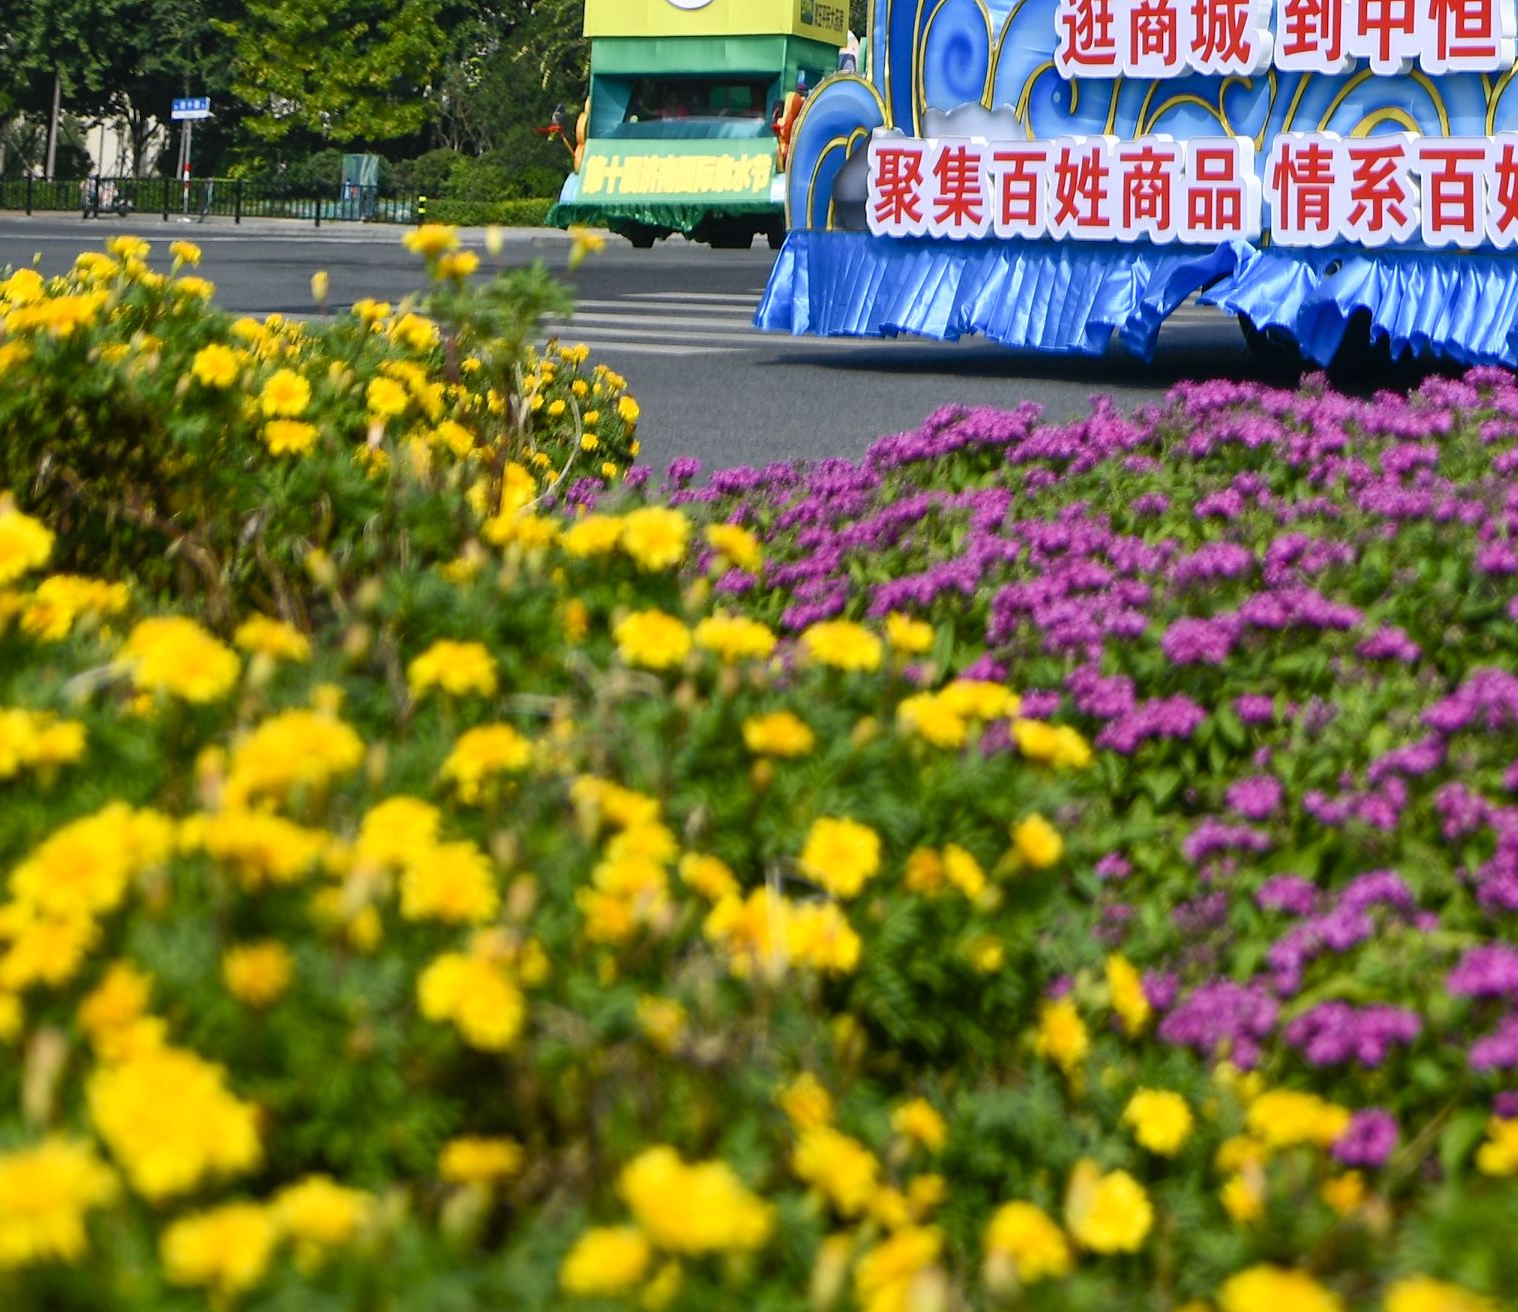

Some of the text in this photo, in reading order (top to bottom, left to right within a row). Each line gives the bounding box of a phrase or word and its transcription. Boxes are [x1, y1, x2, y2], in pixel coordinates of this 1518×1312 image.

[873, 145, 1242, 231] 聚集百姓商品
